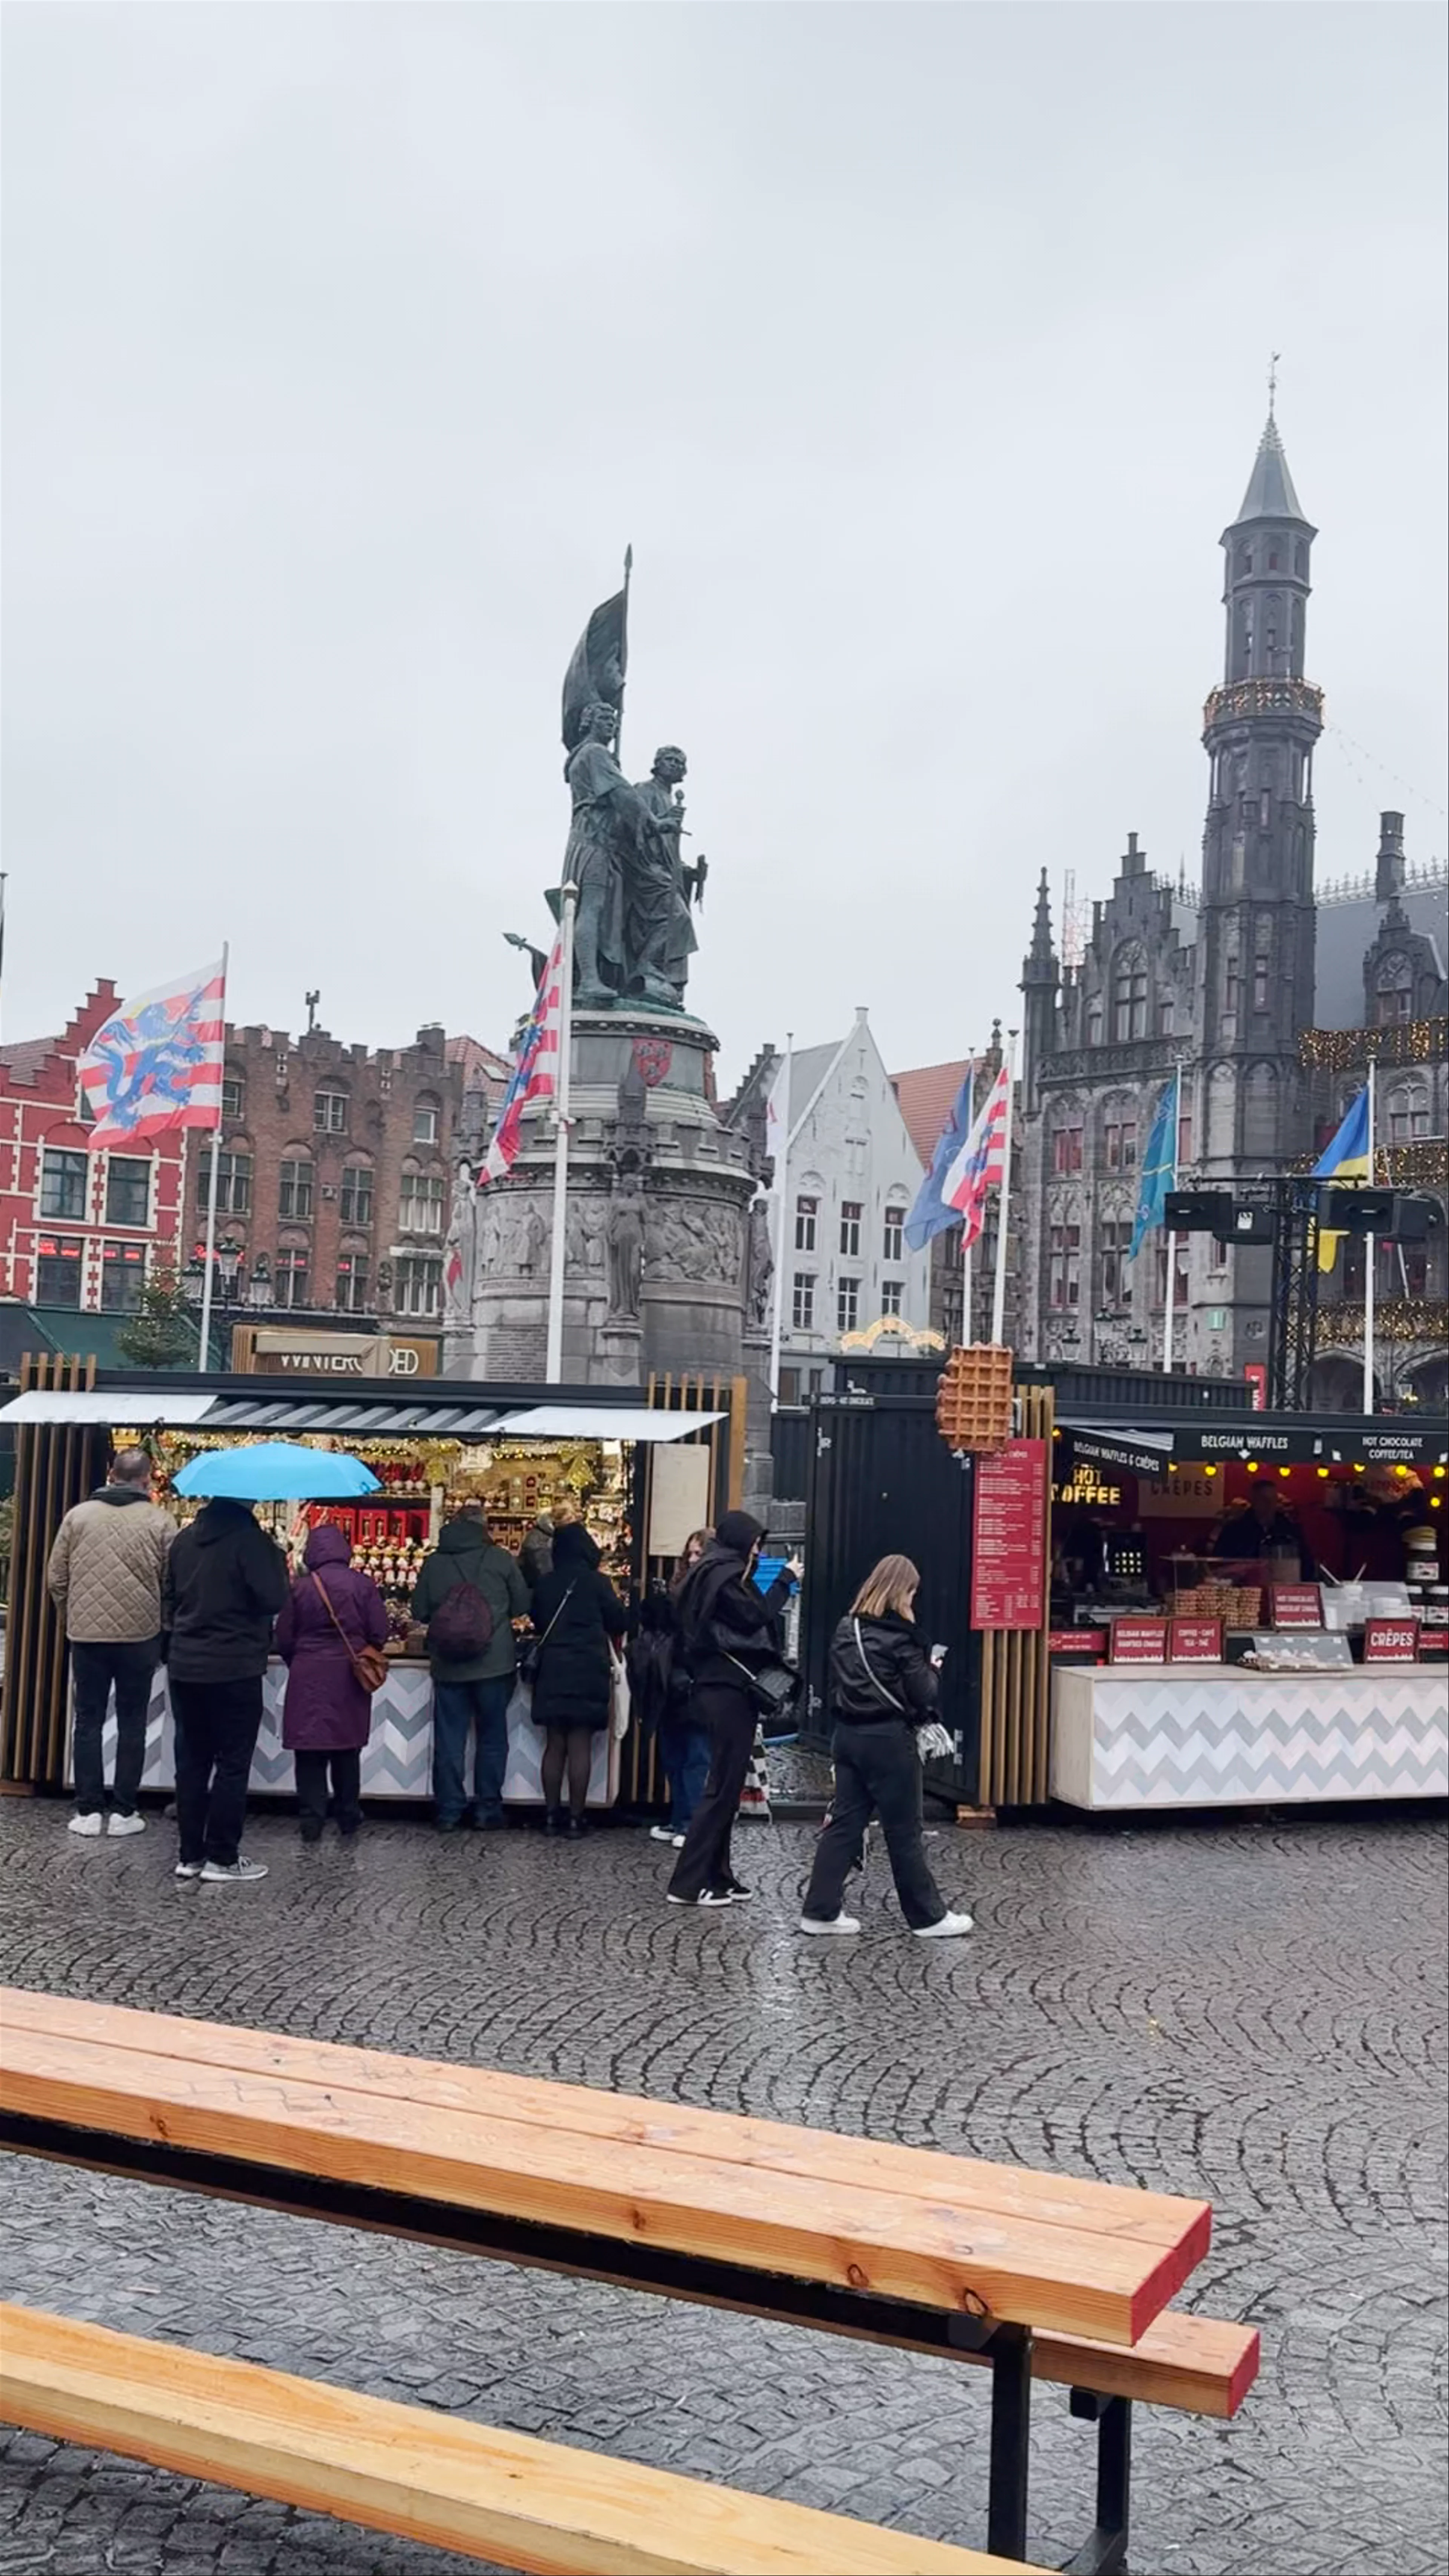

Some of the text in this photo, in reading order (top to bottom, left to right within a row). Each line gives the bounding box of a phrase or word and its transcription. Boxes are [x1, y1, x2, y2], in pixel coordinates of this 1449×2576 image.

[1201, 1435, 1288, 1449] BELGIAN WAFFLES
[1362, 1436, 1423, 1447] HOT CHOCOLATE
[1074, 1441, 1100, 1457] BELGIAN
[1101, 1448, 1127, 1464] WAFFLES
[1135, 1455, 1160, 1472] CRÊPES
[1073, 1469, 1100, 1486] HOT
[1371, 1629, 1414, 1647] CRÊPES
